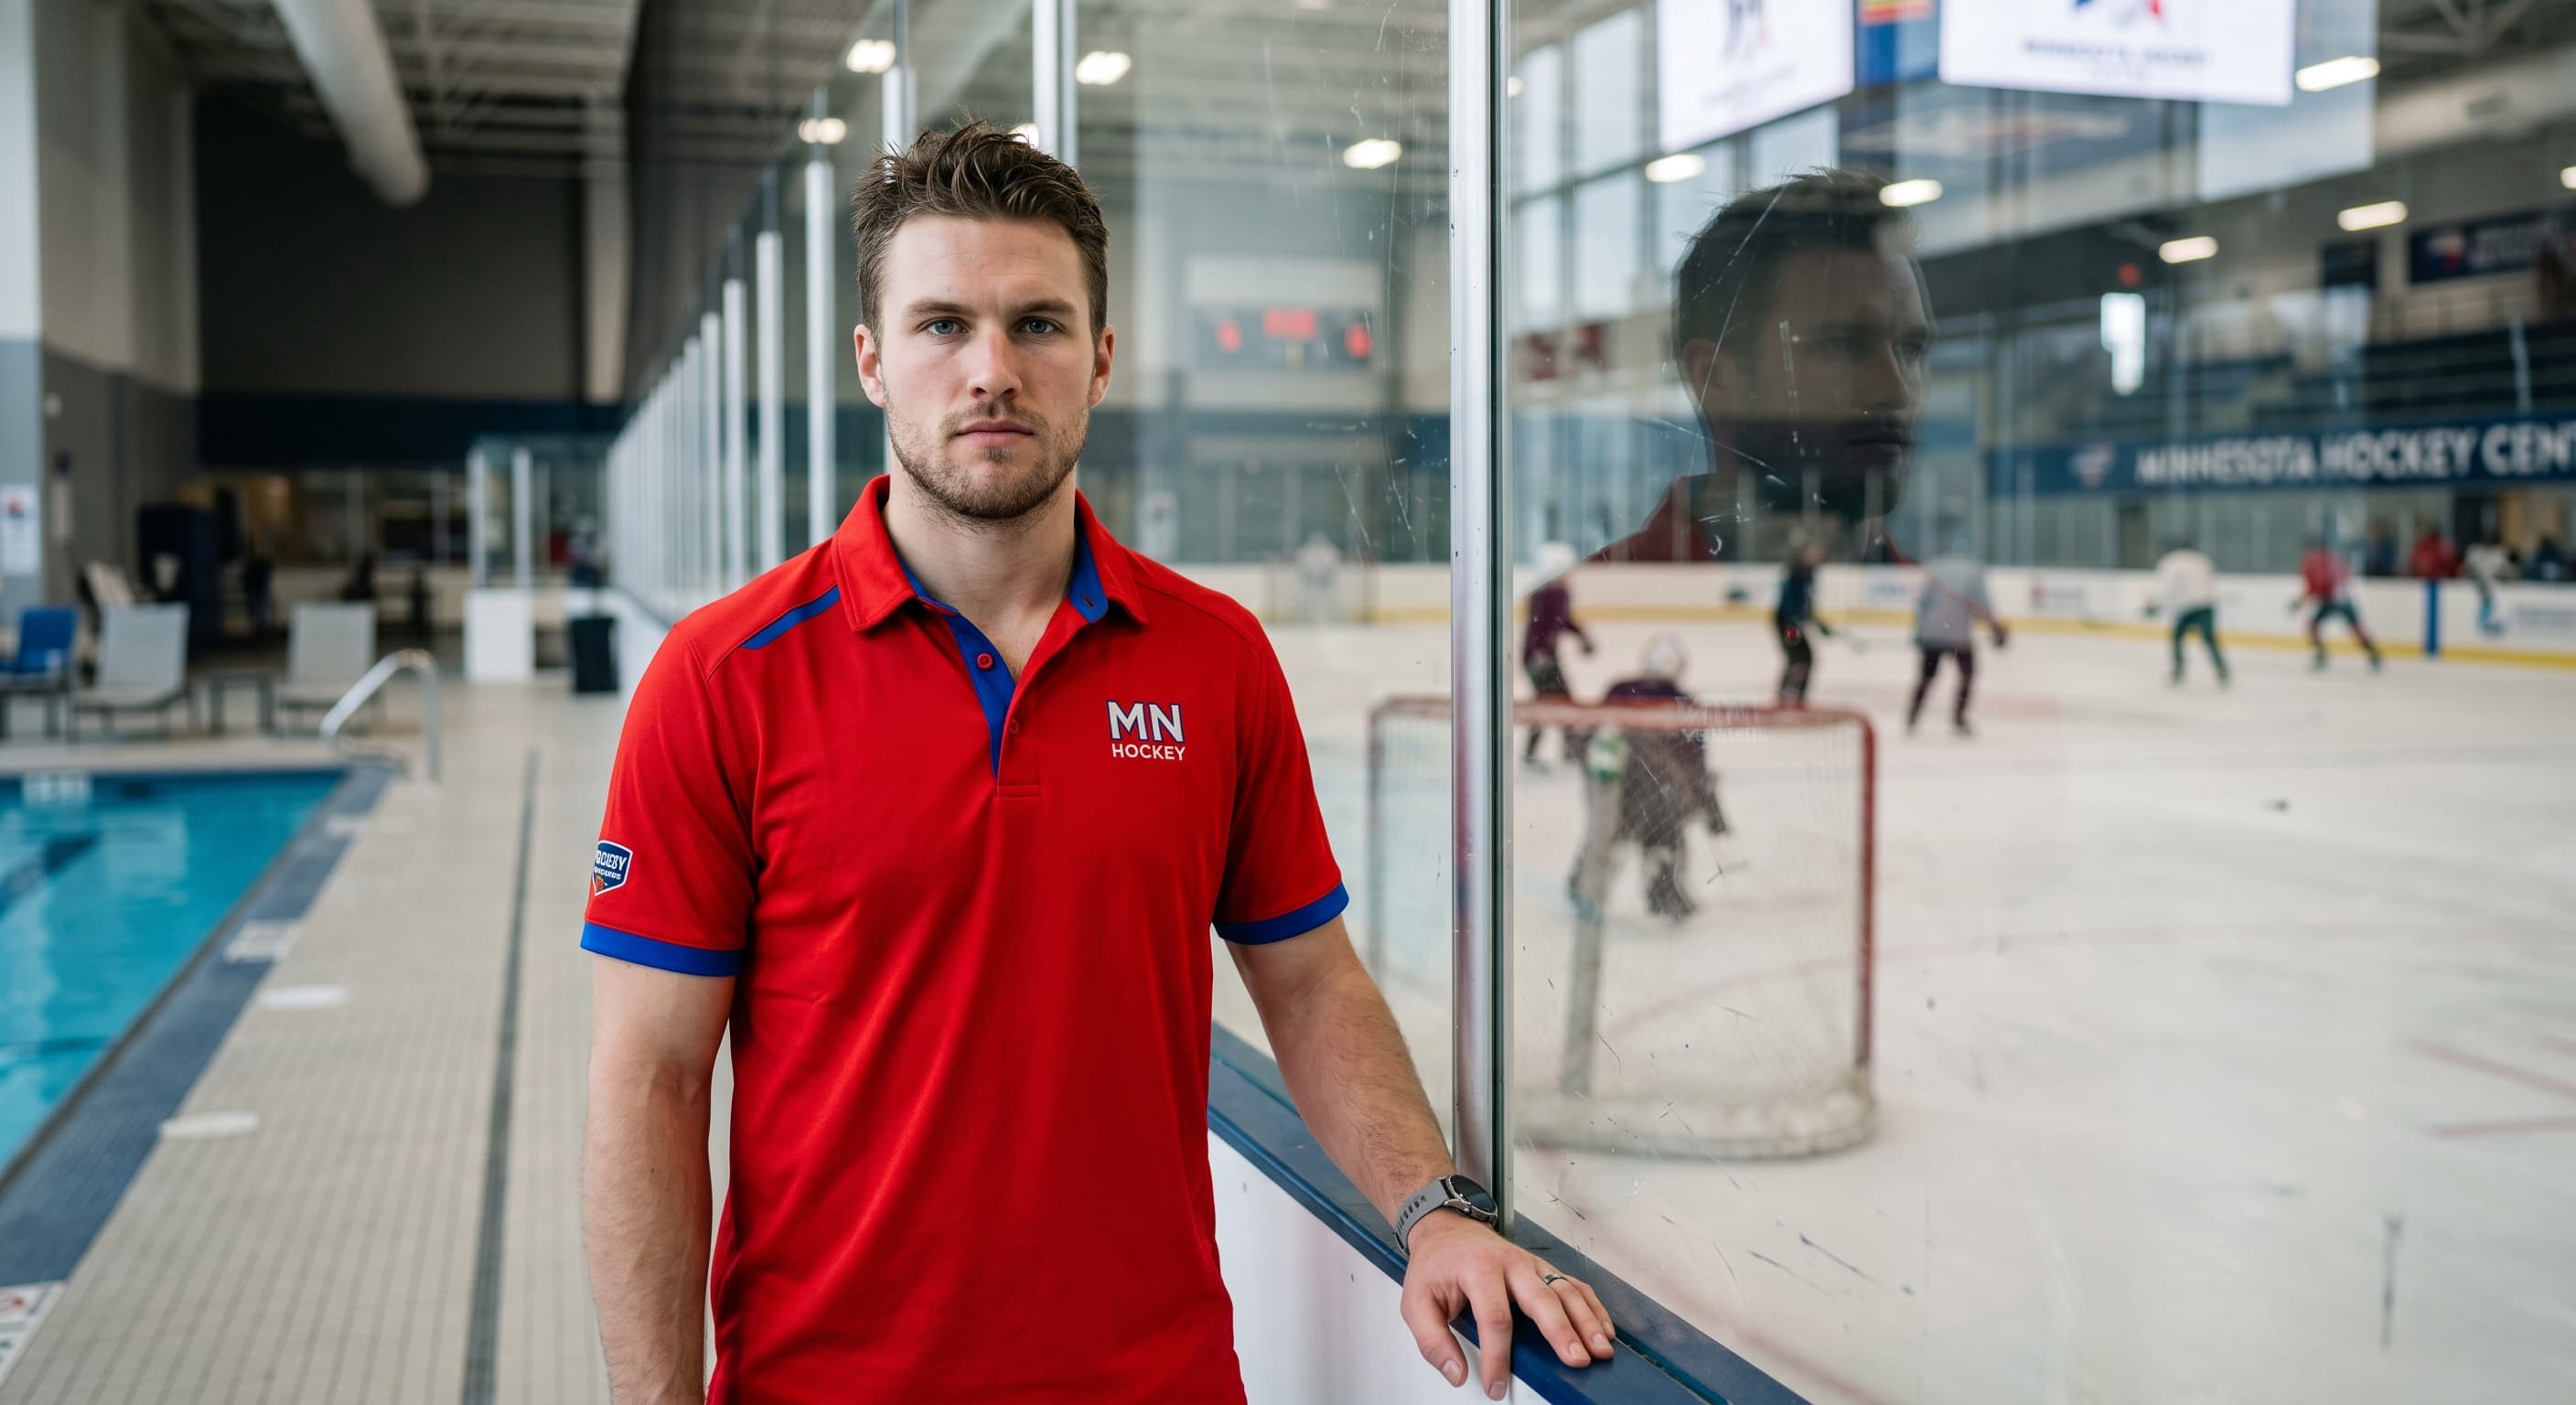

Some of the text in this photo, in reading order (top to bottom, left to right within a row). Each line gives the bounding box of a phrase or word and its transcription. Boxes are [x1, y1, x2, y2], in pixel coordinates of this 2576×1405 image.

[2321, 426, 2475, 480] HOCKEY
[1106, 700, 1186, 743] MN
[1111, 743, 1186, 761] HOCKEY
